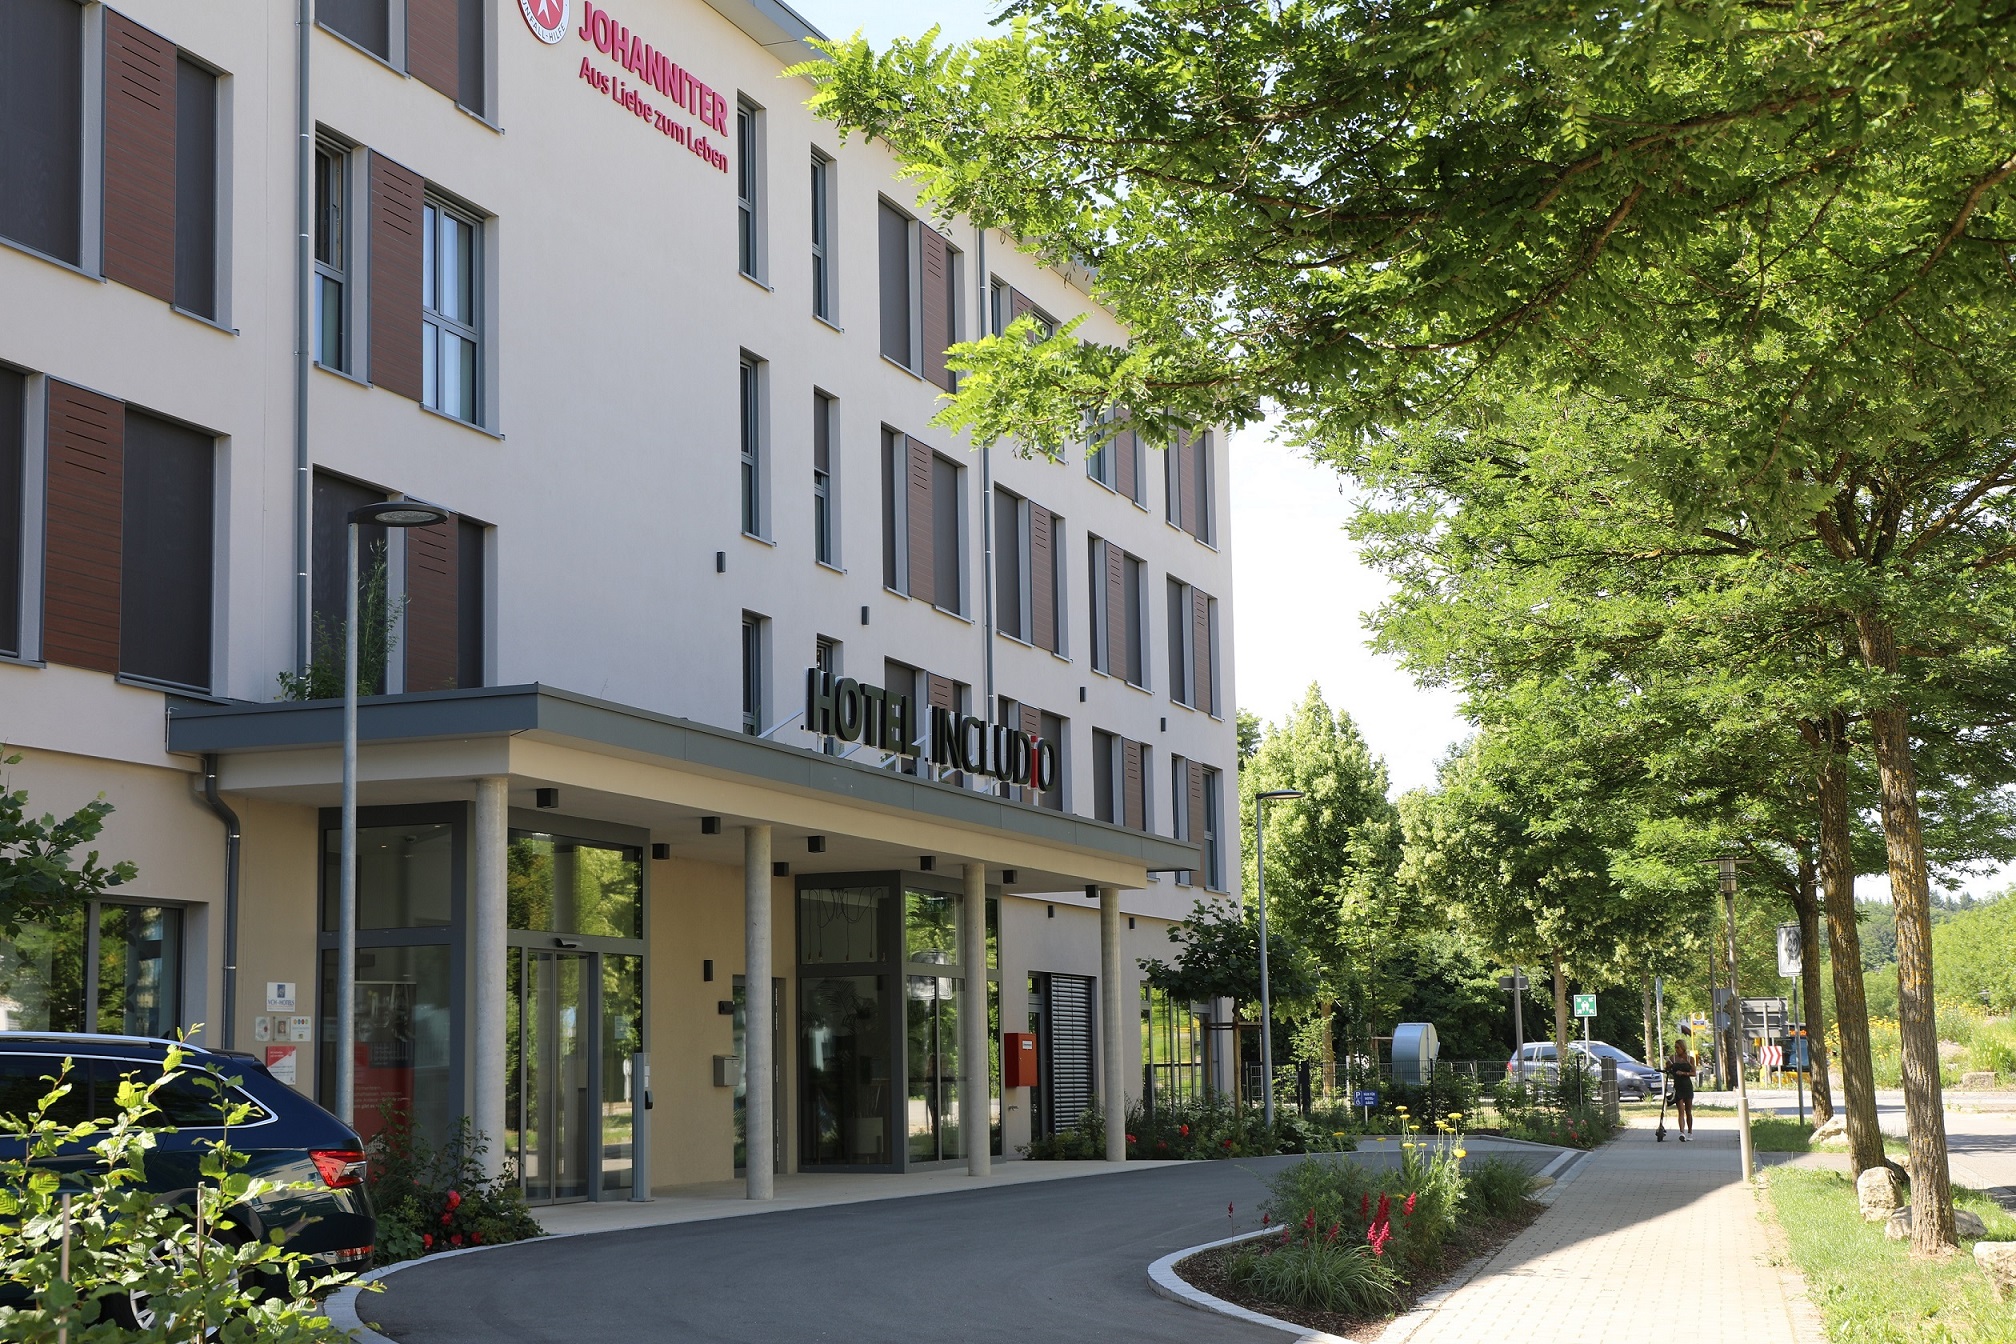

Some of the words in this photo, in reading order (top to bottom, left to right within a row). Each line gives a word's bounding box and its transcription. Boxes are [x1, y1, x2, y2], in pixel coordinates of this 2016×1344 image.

[579, 0, 728, 137] JOHANNITER
[579, 56, 610, 95] Aus
[612, 76, 653, 123] Liebe
[654, 109, 685, 145] zum
[687, 126, 728, 173] Leben
[806, 667, 921, 758] HOTEL
